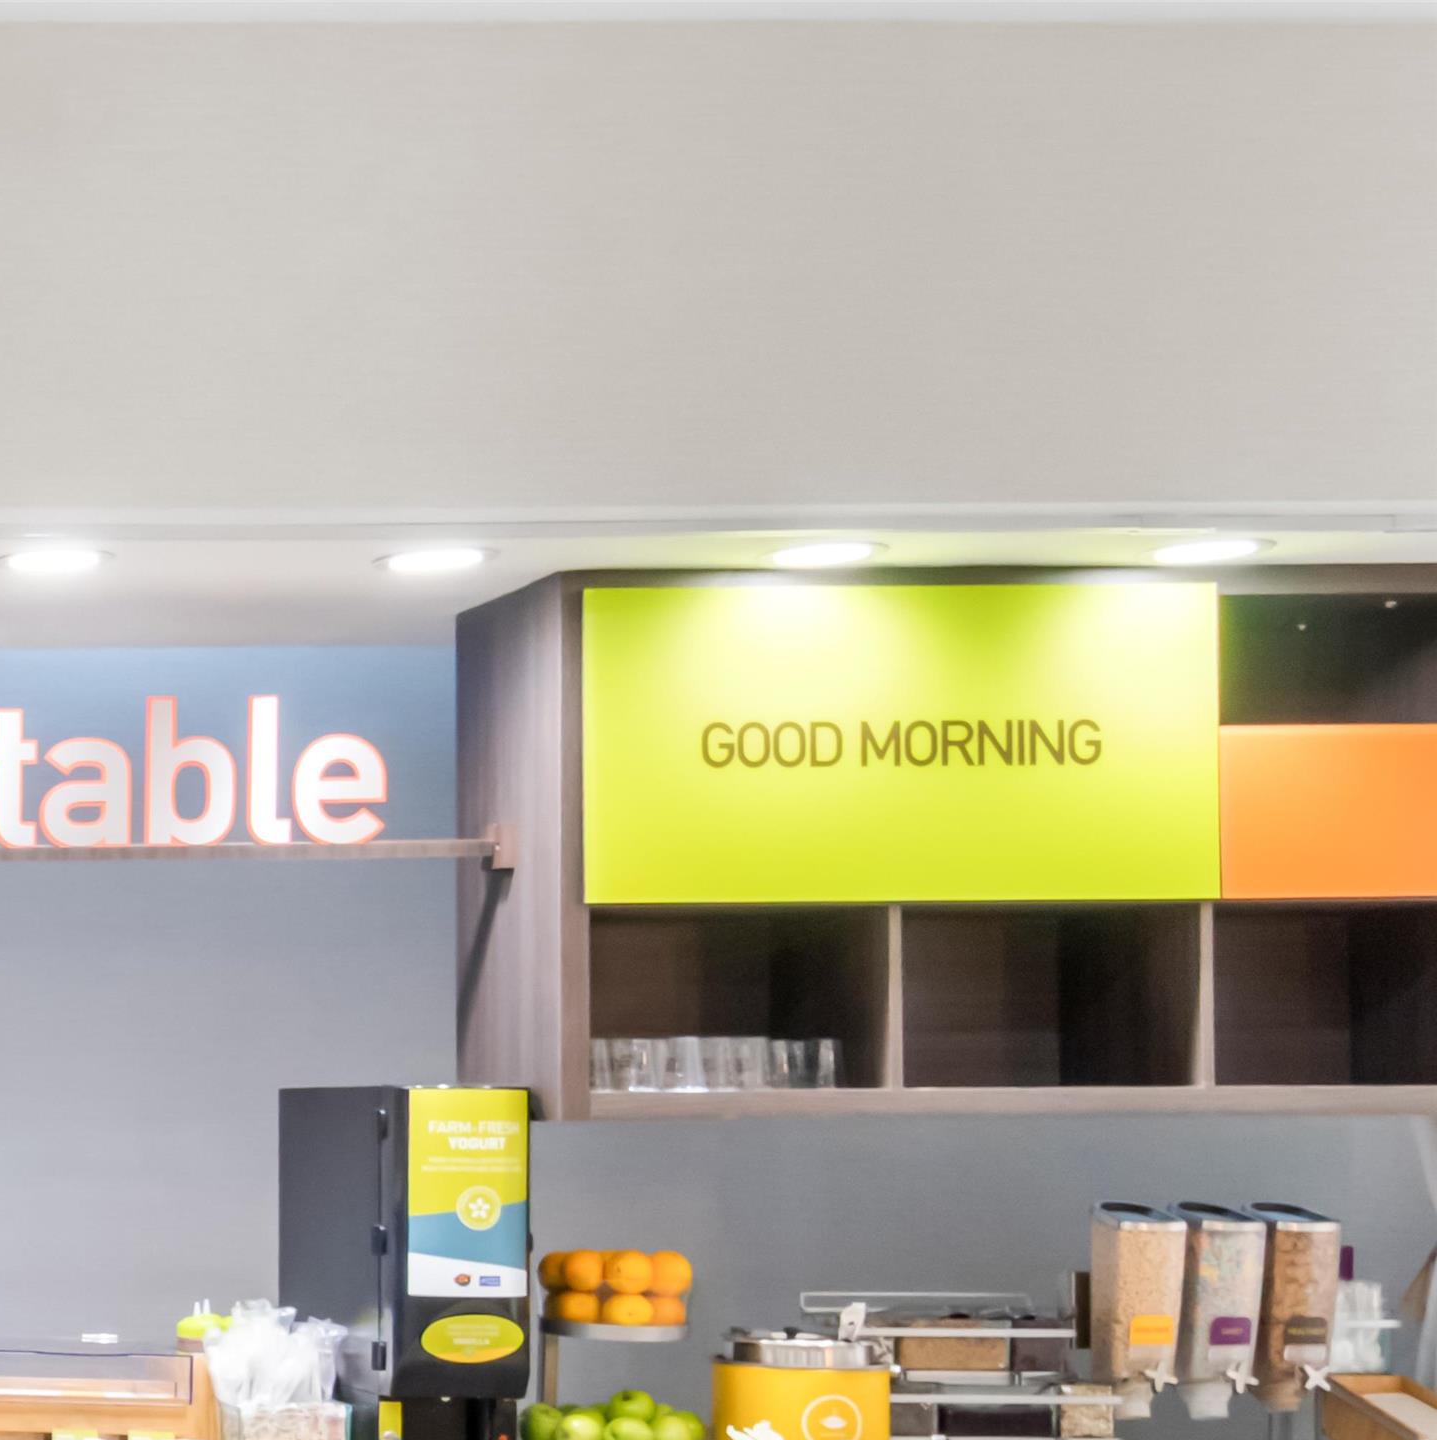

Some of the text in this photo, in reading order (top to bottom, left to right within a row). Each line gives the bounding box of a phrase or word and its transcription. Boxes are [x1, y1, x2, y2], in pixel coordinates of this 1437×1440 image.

[701, 719, 1103, 769] GOOD MORNING
[448, 1136, 506, 1151] YOGURT
